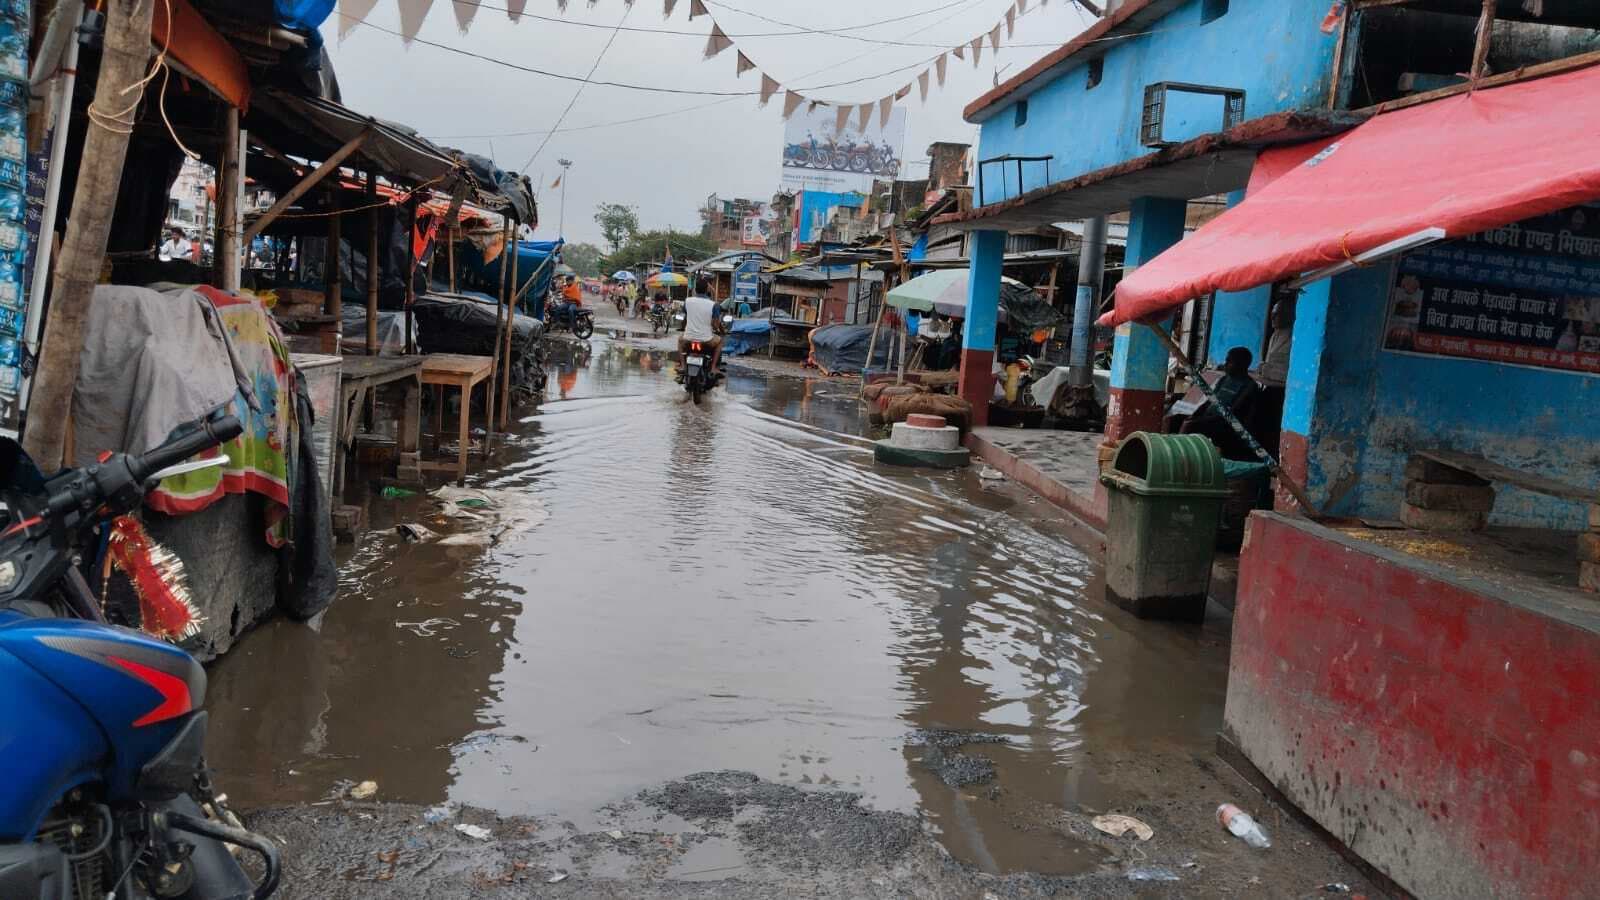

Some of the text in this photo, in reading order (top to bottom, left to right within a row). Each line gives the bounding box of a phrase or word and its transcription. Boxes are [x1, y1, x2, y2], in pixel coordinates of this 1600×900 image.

[1431, 287, 1449, 302] अब
[1450, 287, 1480, 306] आपके
[1547, 297, 1558, 316] में
[1426, 308, 1448, 328] बिना
[1478, 314, 1498, 334] बिना
[1520, 322, 1533, 338] का
